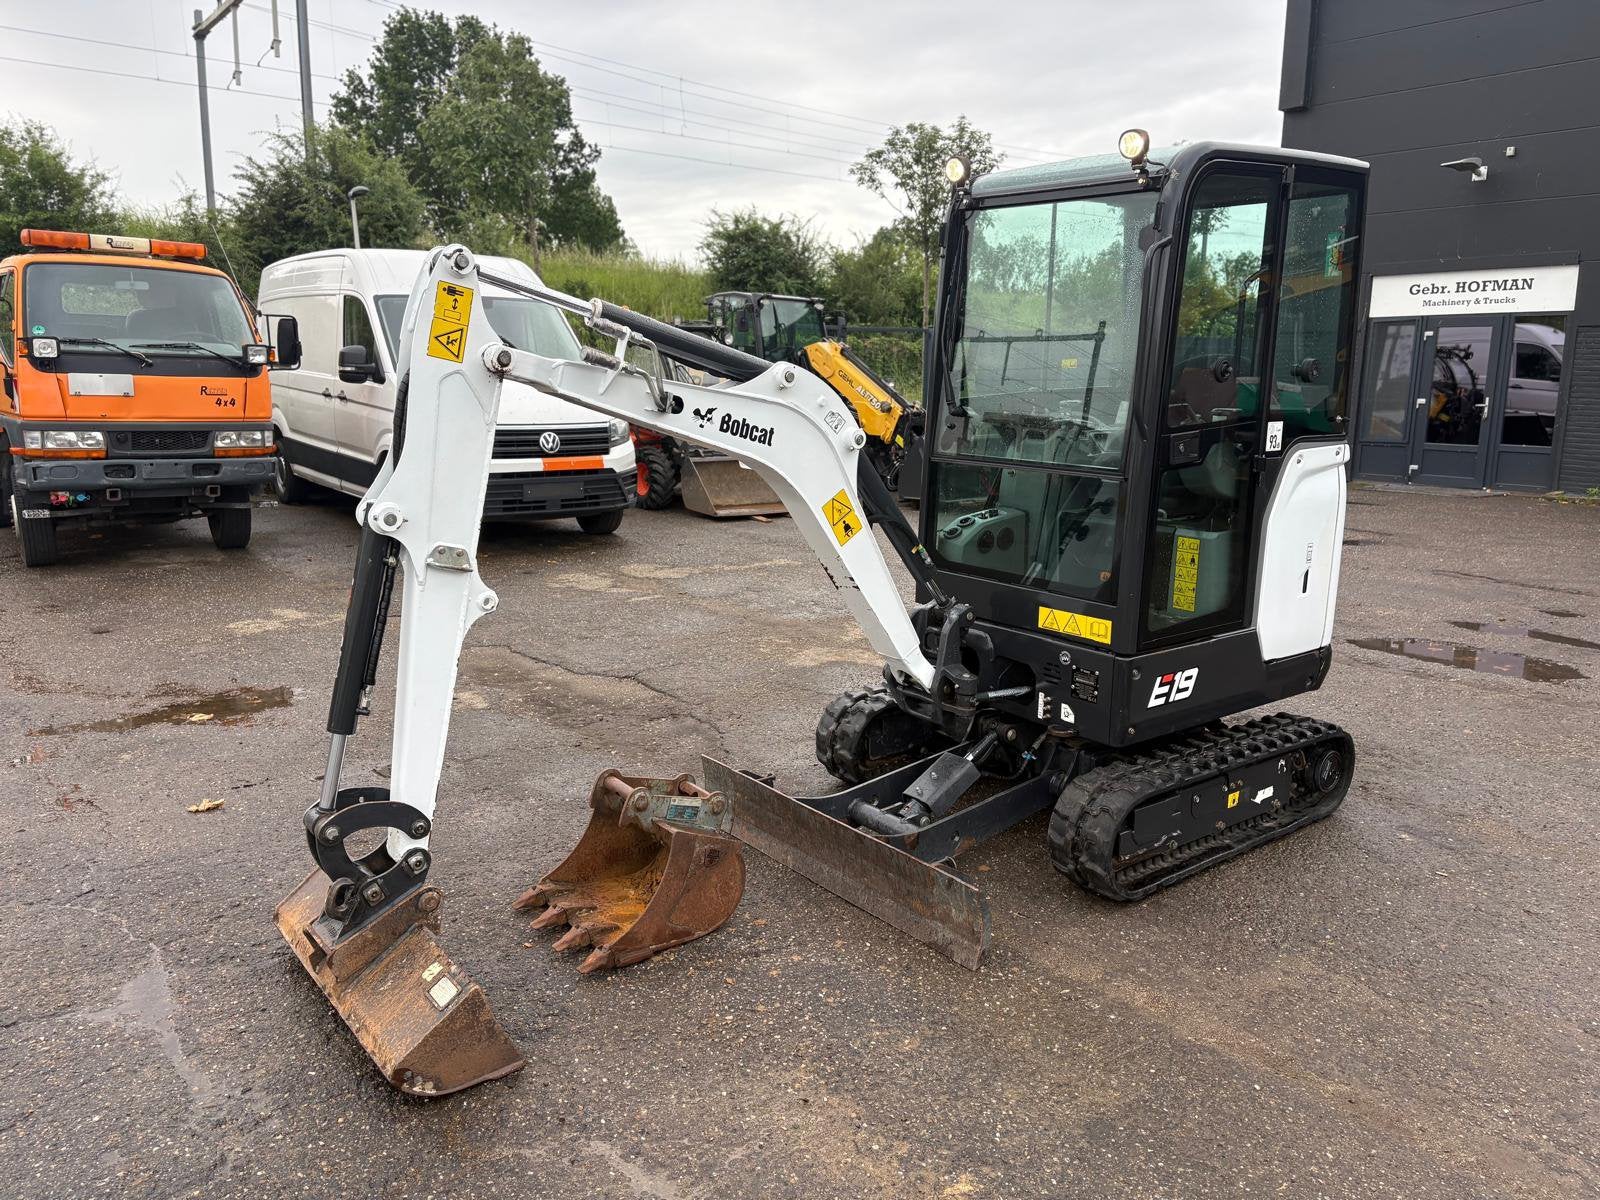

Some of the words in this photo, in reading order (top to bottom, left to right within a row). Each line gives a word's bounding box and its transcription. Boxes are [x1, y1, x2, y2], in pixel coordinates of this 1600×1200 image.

[1409, 283, 1451, 295] Gebr.
[1454, 278, 1535, 293] HOFMAN
[1422, 299, 1472, 307] Machinery
[1482, 296, 1517, 305] Trucks
[838, 369, 855, 389] GEHL
[215, 397, 236, 407] 4x4
[719, 413, 775, 447] Bobcat
[1147, 667, 1199, 709] E19
